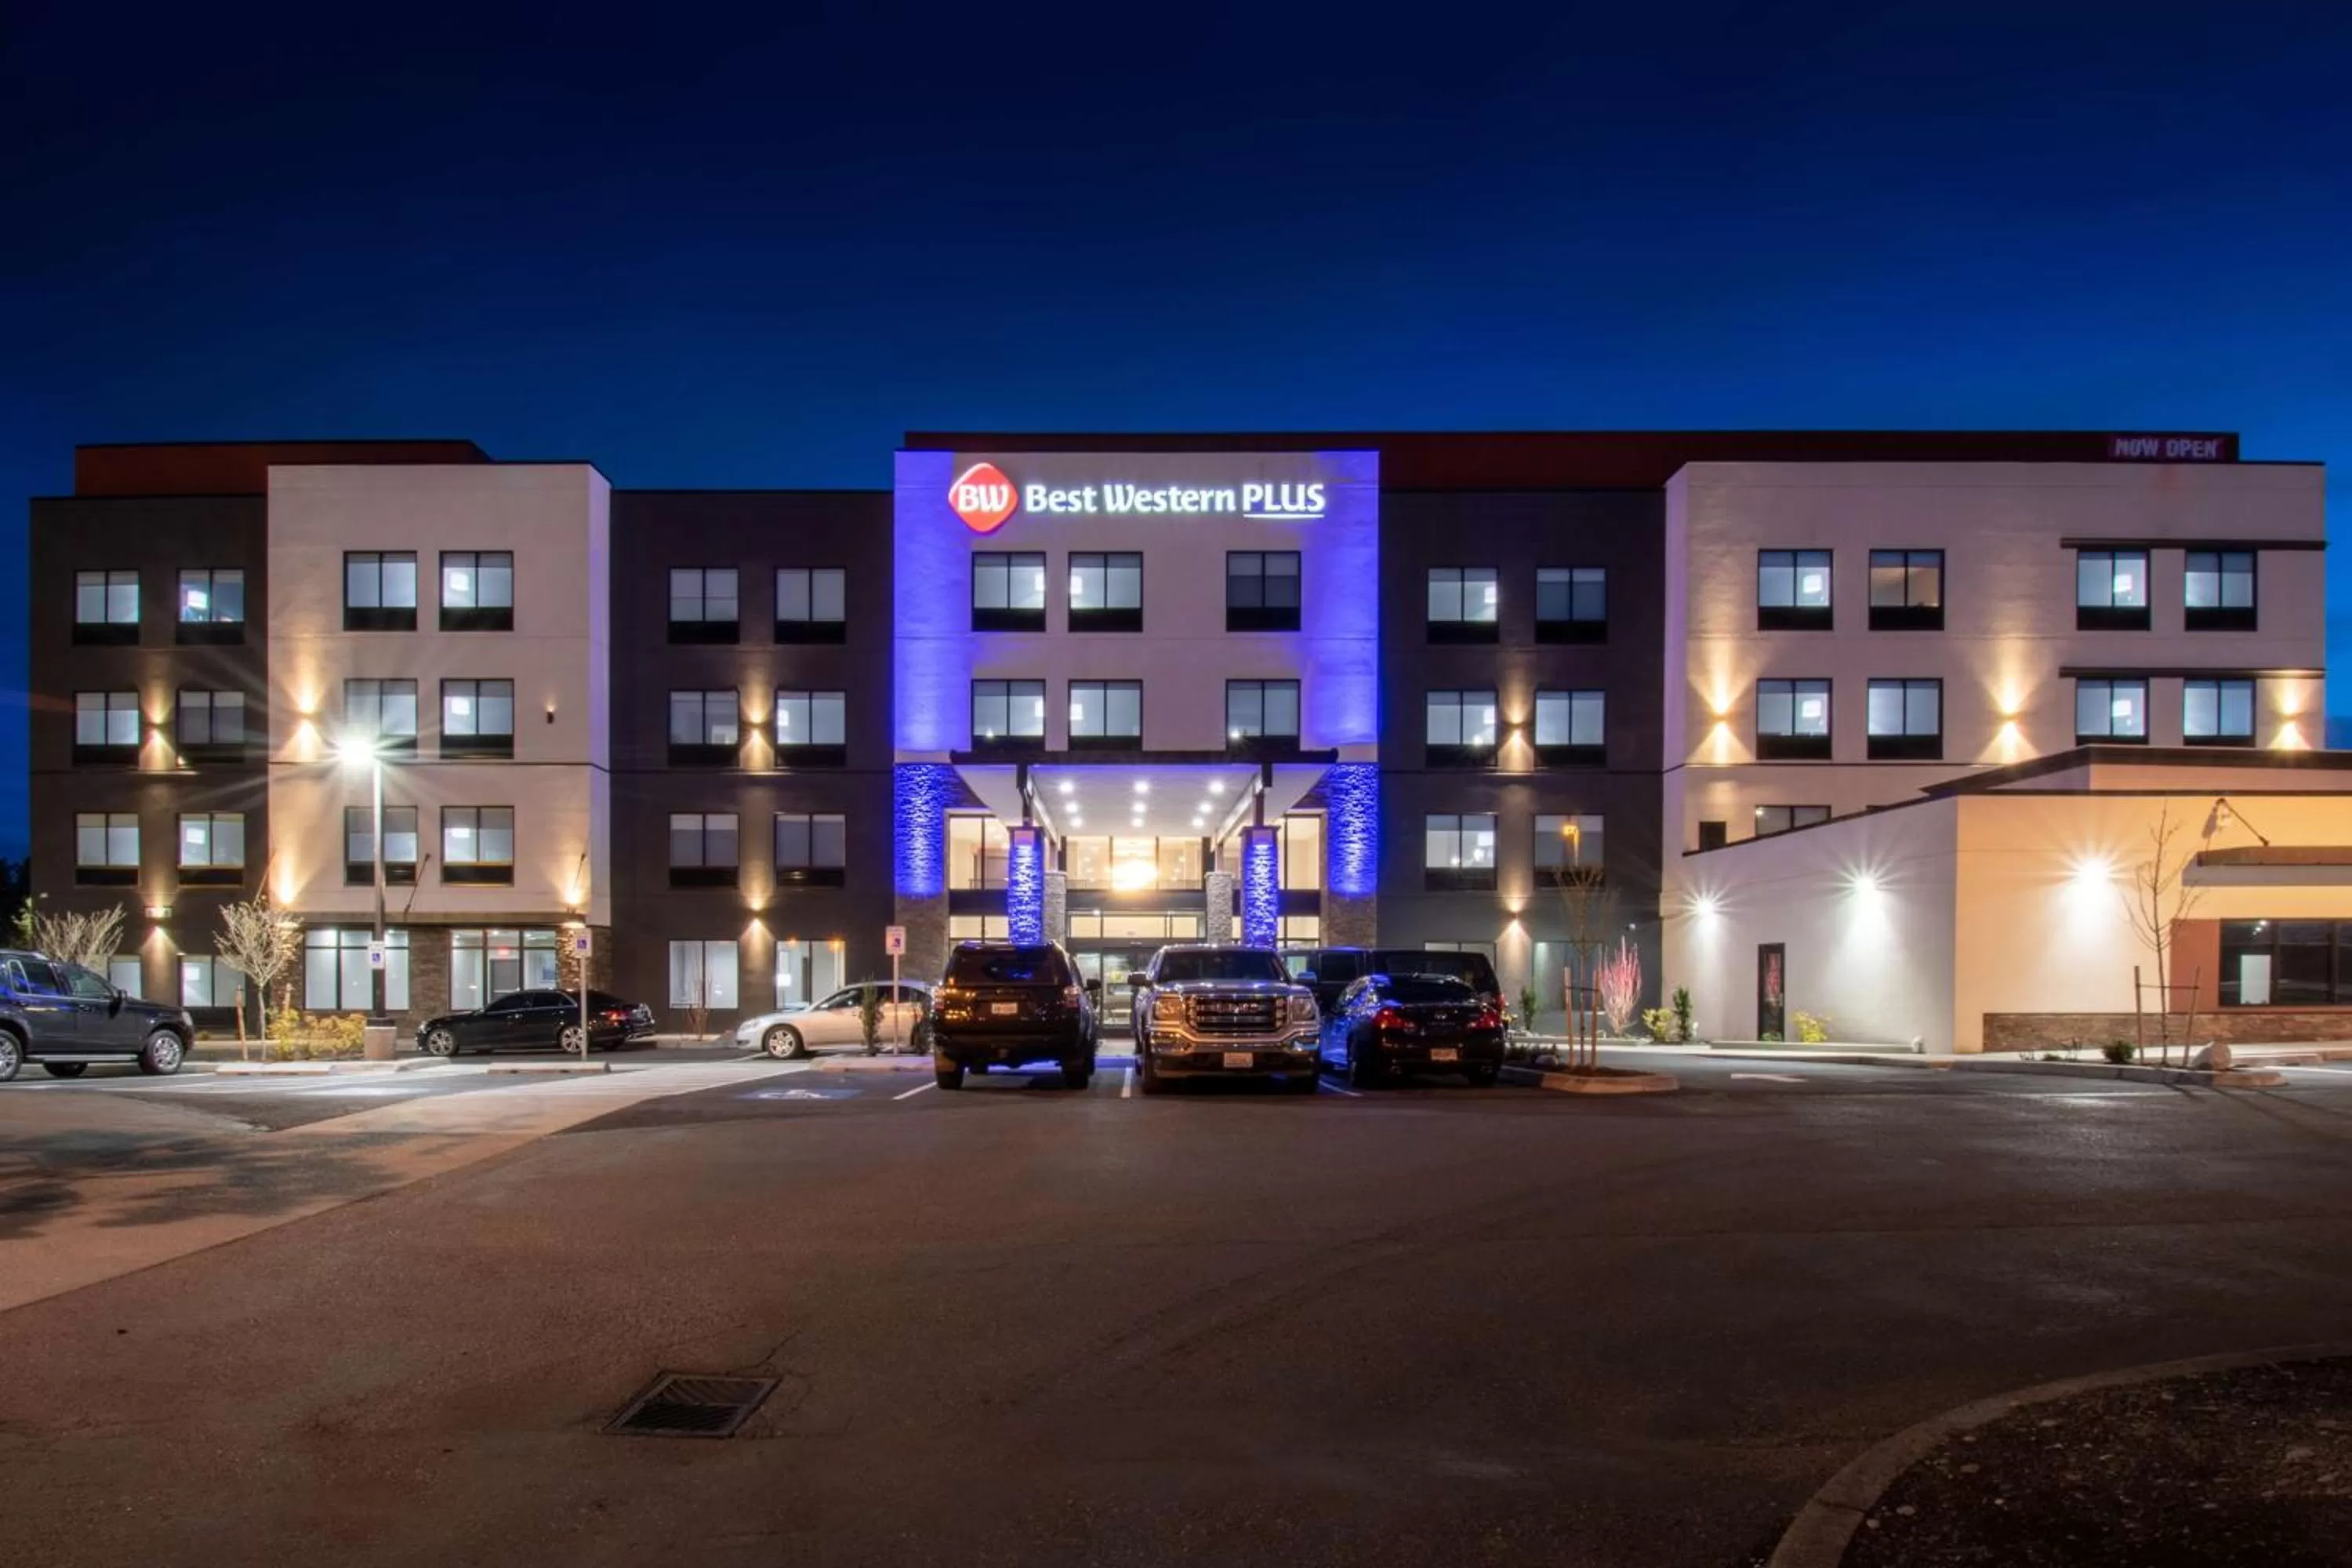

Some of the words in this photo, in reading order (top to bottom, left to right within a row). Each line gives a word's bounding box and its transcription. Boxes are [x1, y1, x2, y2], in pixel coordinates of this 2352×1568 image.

[2115, 438, 2158, 456] NOW
[2166, 439, 2217, 458] OPEN
[958, 484, 1008, 512] BW
[1025, 484, 1098, 513] Best
[1103, 484, 1236, 513] Western
[1243, 484, 1326, 512] PLUS
